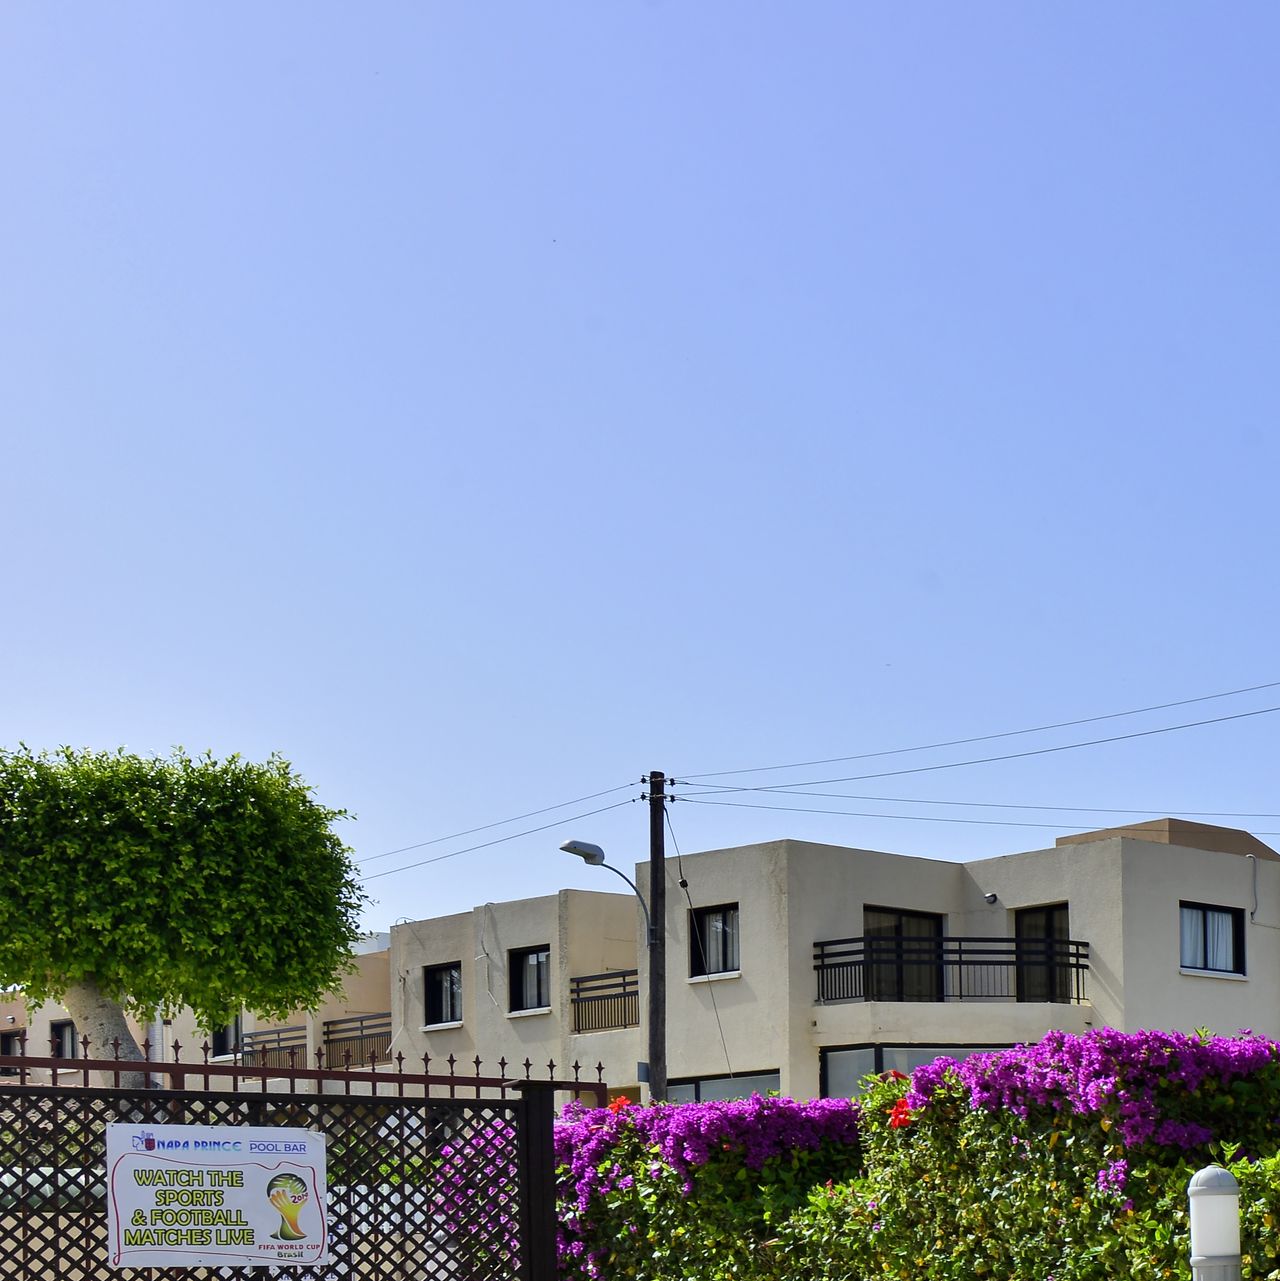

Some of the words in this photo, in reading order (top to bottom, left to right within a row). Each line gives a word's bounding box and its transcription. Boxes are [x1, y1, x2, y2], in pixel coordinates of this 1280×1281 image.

[157, 1140, 190, 1151] NAPA
[194, 1141, 242, 1152] PRINCE
[250, 1143, 280, 1152] POOL
[284, 1143, 307, 1152] BAR
[134, 1169, 204, 1187] WATCH
[207, 1170, 244, 1188] THE
[155, 1189, 225, 1207] SPORTS
[131, 1208, 148, 1226] &
[150, 1209, 248, 1226] FOOTBALL
[124, 1228, 212, 1246] MATCHES
[215, 1229, 255, 1246] LIVE
[258, 1243, 275, 1251] FIFA
[277, 1243, 304, 1251] WORLD
[306, 1243, 321, 1251] CUP
